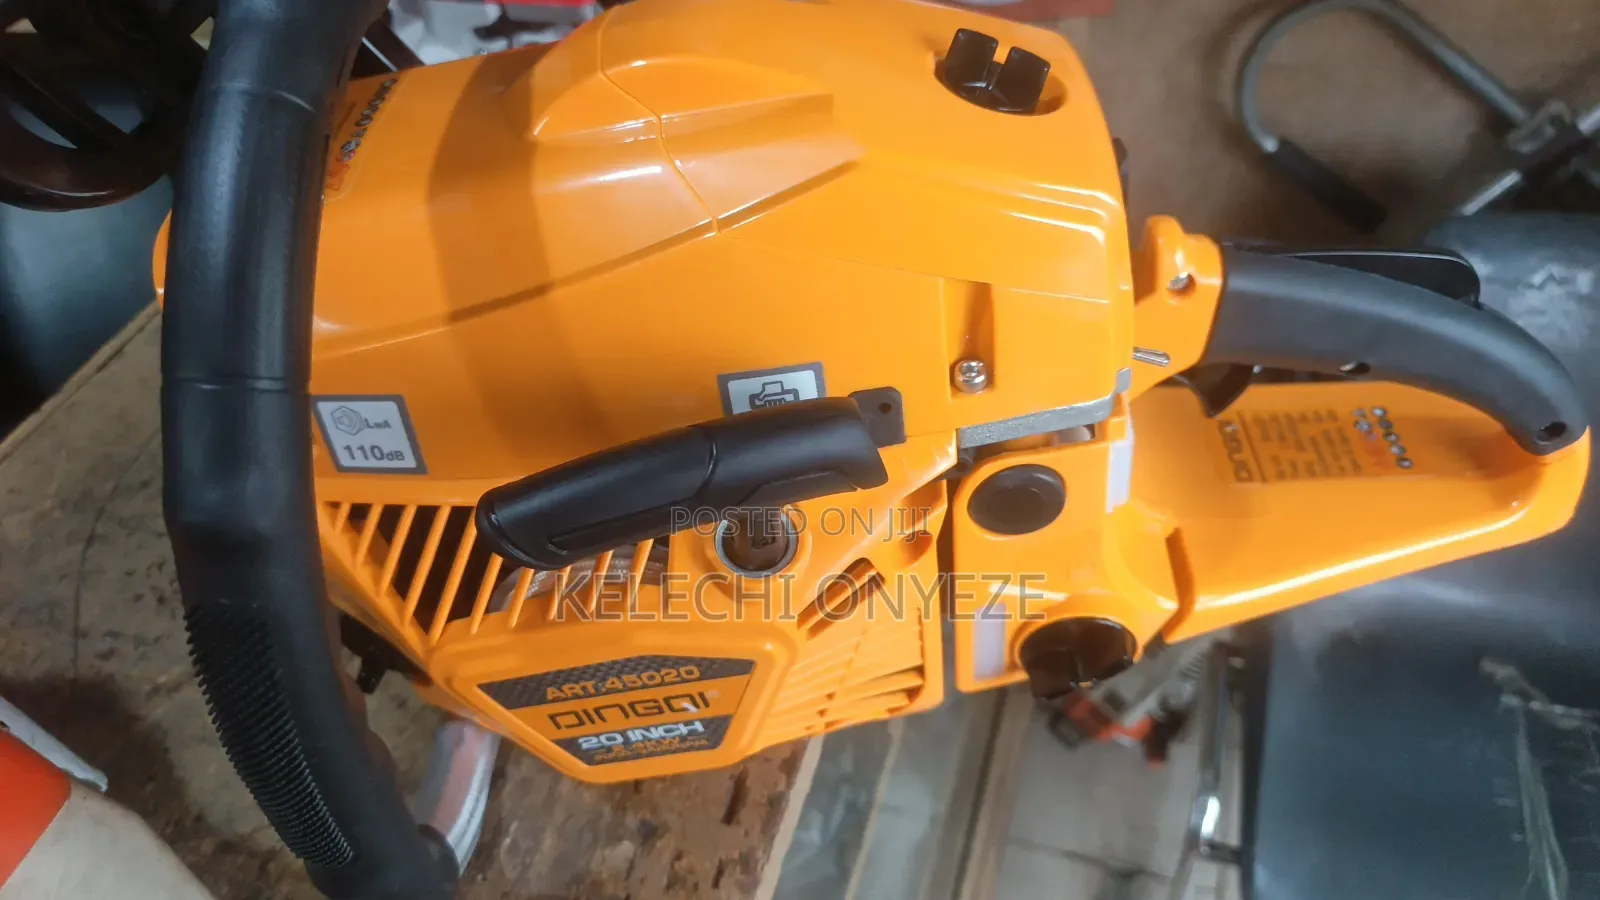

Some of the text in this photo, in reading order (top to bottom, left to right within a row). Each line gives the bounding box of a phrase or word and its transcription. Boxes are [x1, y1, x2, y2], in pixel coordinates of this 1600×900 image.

[547, 692, 710, 730] DINGQI
[578, 733, 624, 750] 20
[626, 720, 705, 742] INCH
